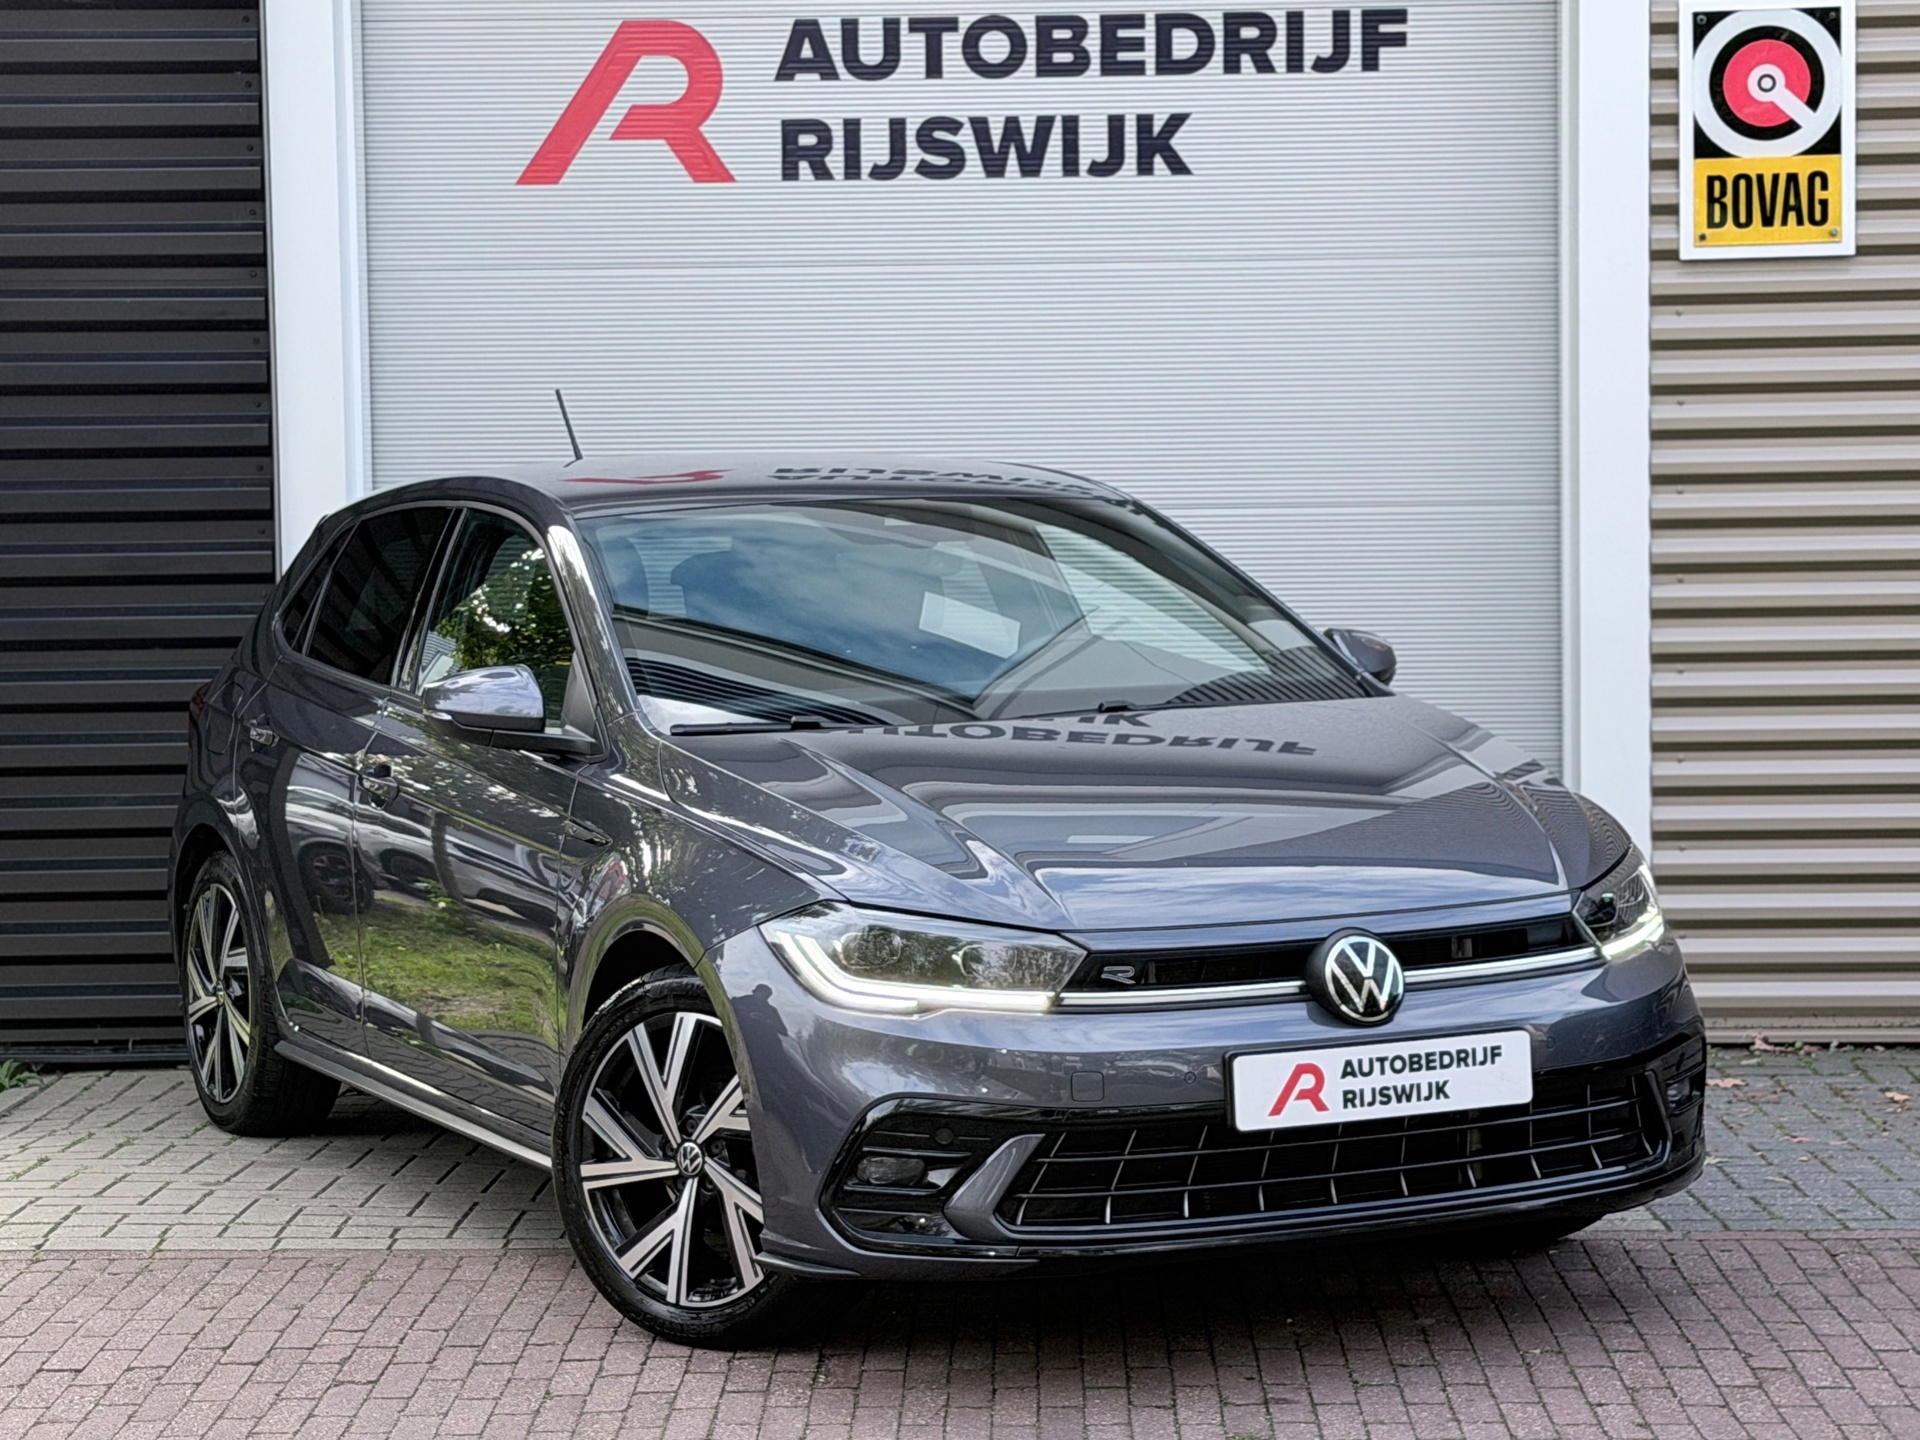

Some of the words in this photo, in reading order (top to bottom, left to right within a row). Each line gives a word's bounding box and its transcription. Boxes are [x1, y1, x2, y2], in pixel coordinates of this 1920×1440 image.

[775, 9, 1408, 82] AUTOBEDRIJF
[780, 113, 1192, 182] RIJSWIJK
[1706, 171, 1829, 229] BOVAG
[1340, 1045, 1503, 1079] AUTOBEDRIJF
[1342, 1080, 1451, 1109] RIJSWIJK
